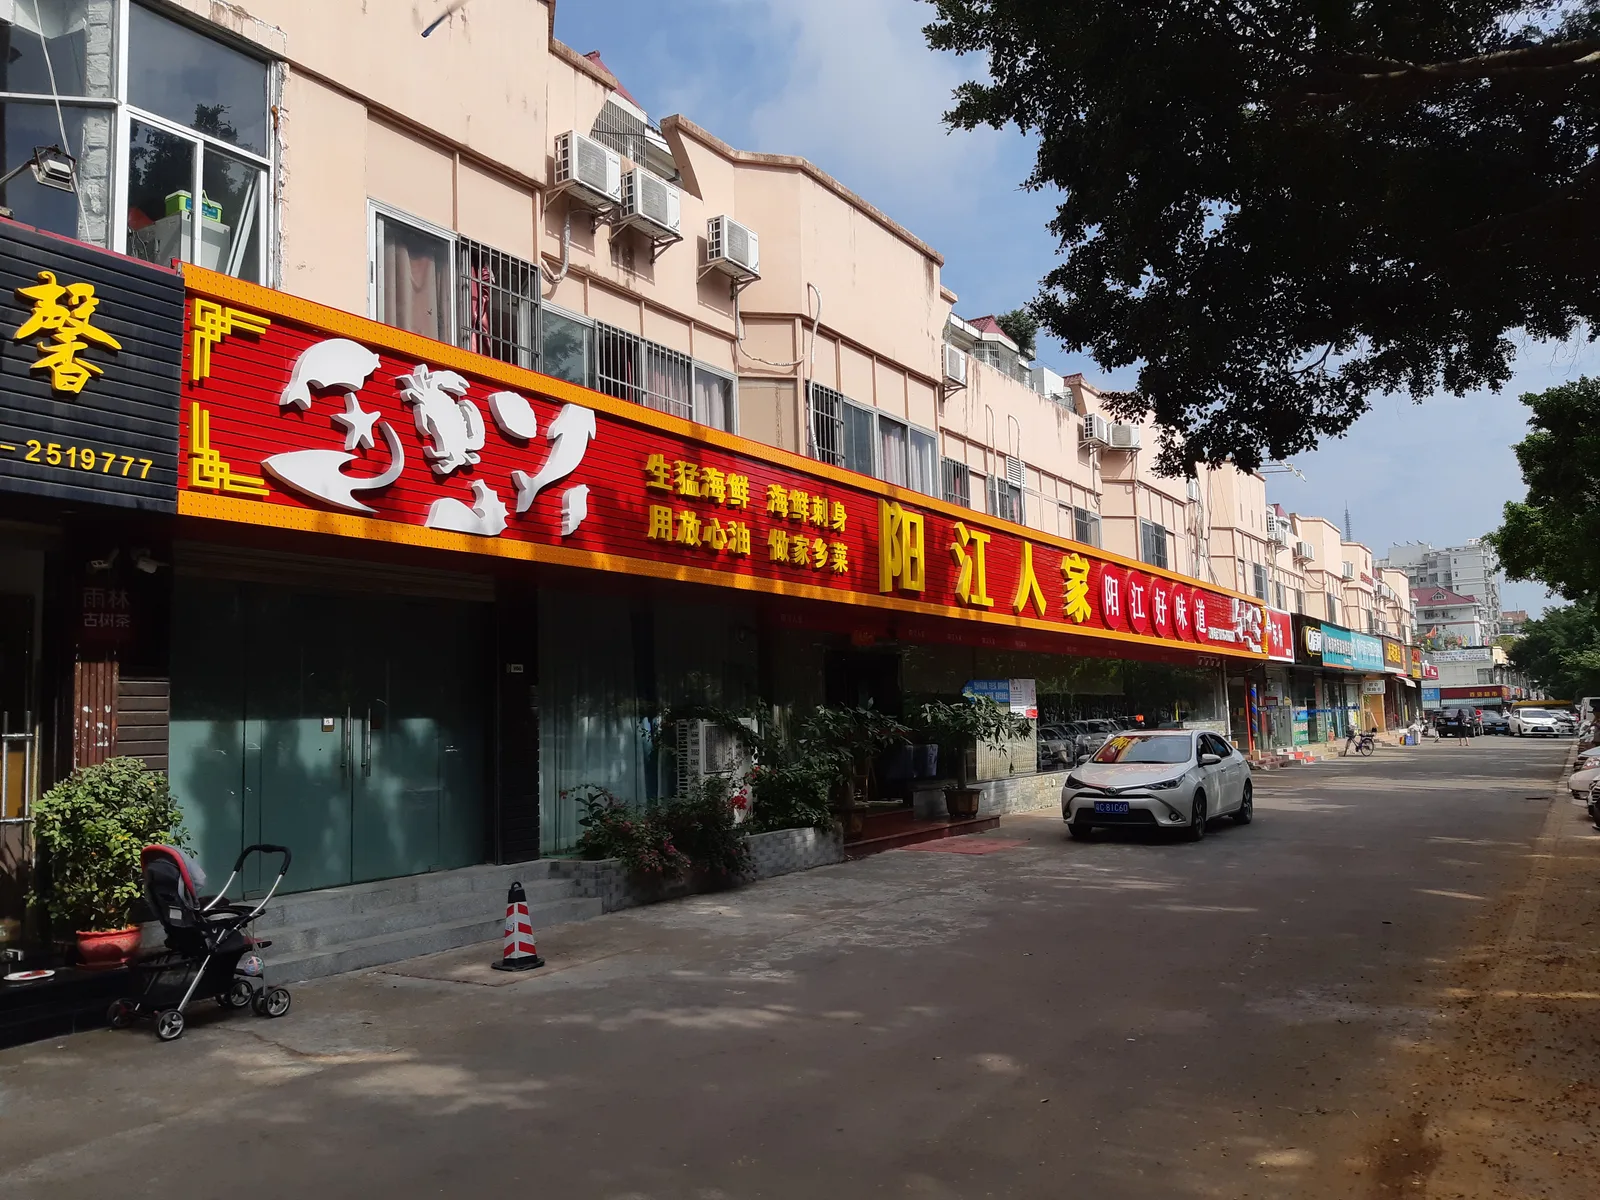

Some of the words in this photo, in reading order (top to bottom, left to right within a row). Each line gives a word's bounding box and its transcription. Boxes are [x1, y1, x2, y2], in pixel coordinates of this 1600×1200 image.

[13, 269, 123, 394] 馨
[645, 453, 750, 510] 生猛海鲜
[766, 483, 848, 533] 海鲜刺身
[647, 503, 751, 557] 用放心油
[767, 528, 849, 574] 做家乡菜
[877, 498, 1092, 624] 阳江人家
[82, 586, 130, 609] 雨林
[83, 612, 132, 628] 古树茶
[1104, 573, 1208, 634] 阳江好味道
